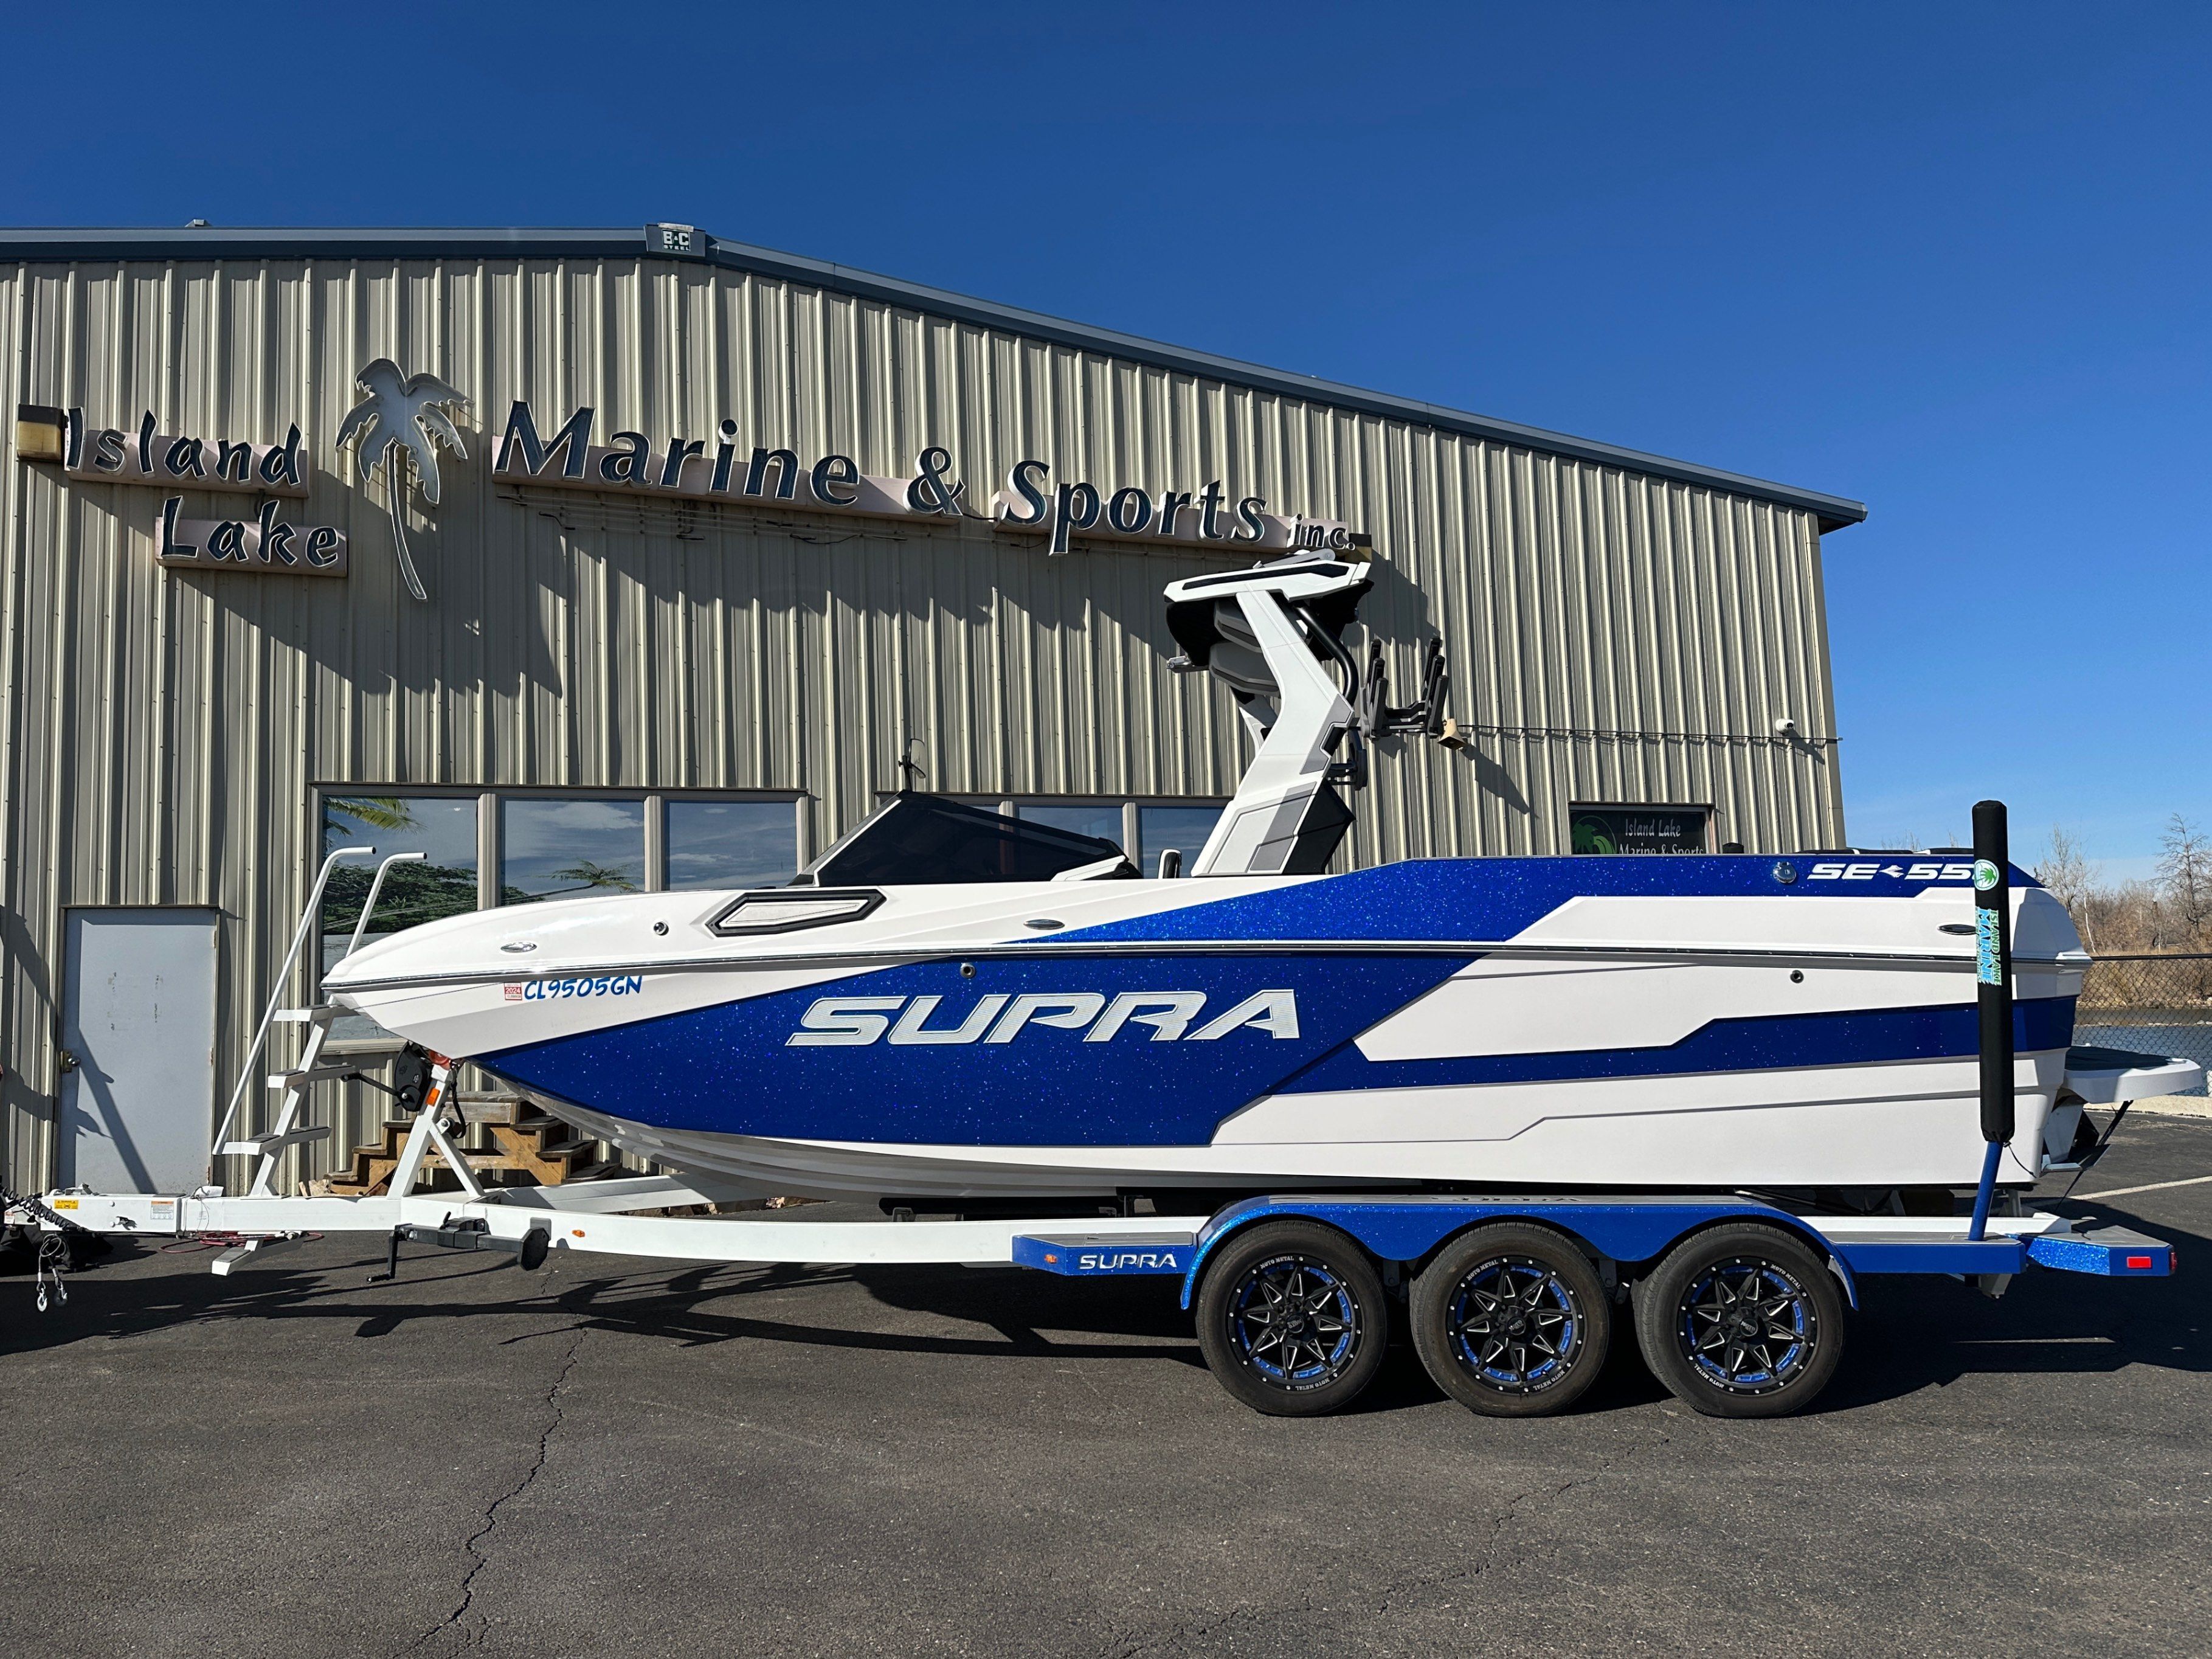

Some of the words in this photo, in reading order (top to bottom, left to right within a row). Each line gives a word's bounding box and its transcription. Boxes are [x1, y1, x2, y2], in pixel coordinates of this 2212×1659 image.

[66, 407, 303, 489] Island
[494, 400, 860, 510] Marine
[903, 445, 967, 517] &
[1002, 459, 1267, 556] Sports
[159, 495, 340, 569] Lake
[1625, 818, 1655, 837] Island
[1658, 819, 1681, 837] Lake
[1904, 863, 1975, 880] 55
[1979, 907, 1995, 985] MARINE
[1989, 910, 2000, 954] ISLAND
[1992, 954, 2002, 986] LAKE
[784, 989, 1301, 1046] SUPRA
[1079, 1253, 1178, 1270] SUPRA
[1260, 1259, 1275, 1269] MOTO
[1465, 1268, 1481, 1281] MOTO
[1479, 1259, 1499, 1271] METAL
